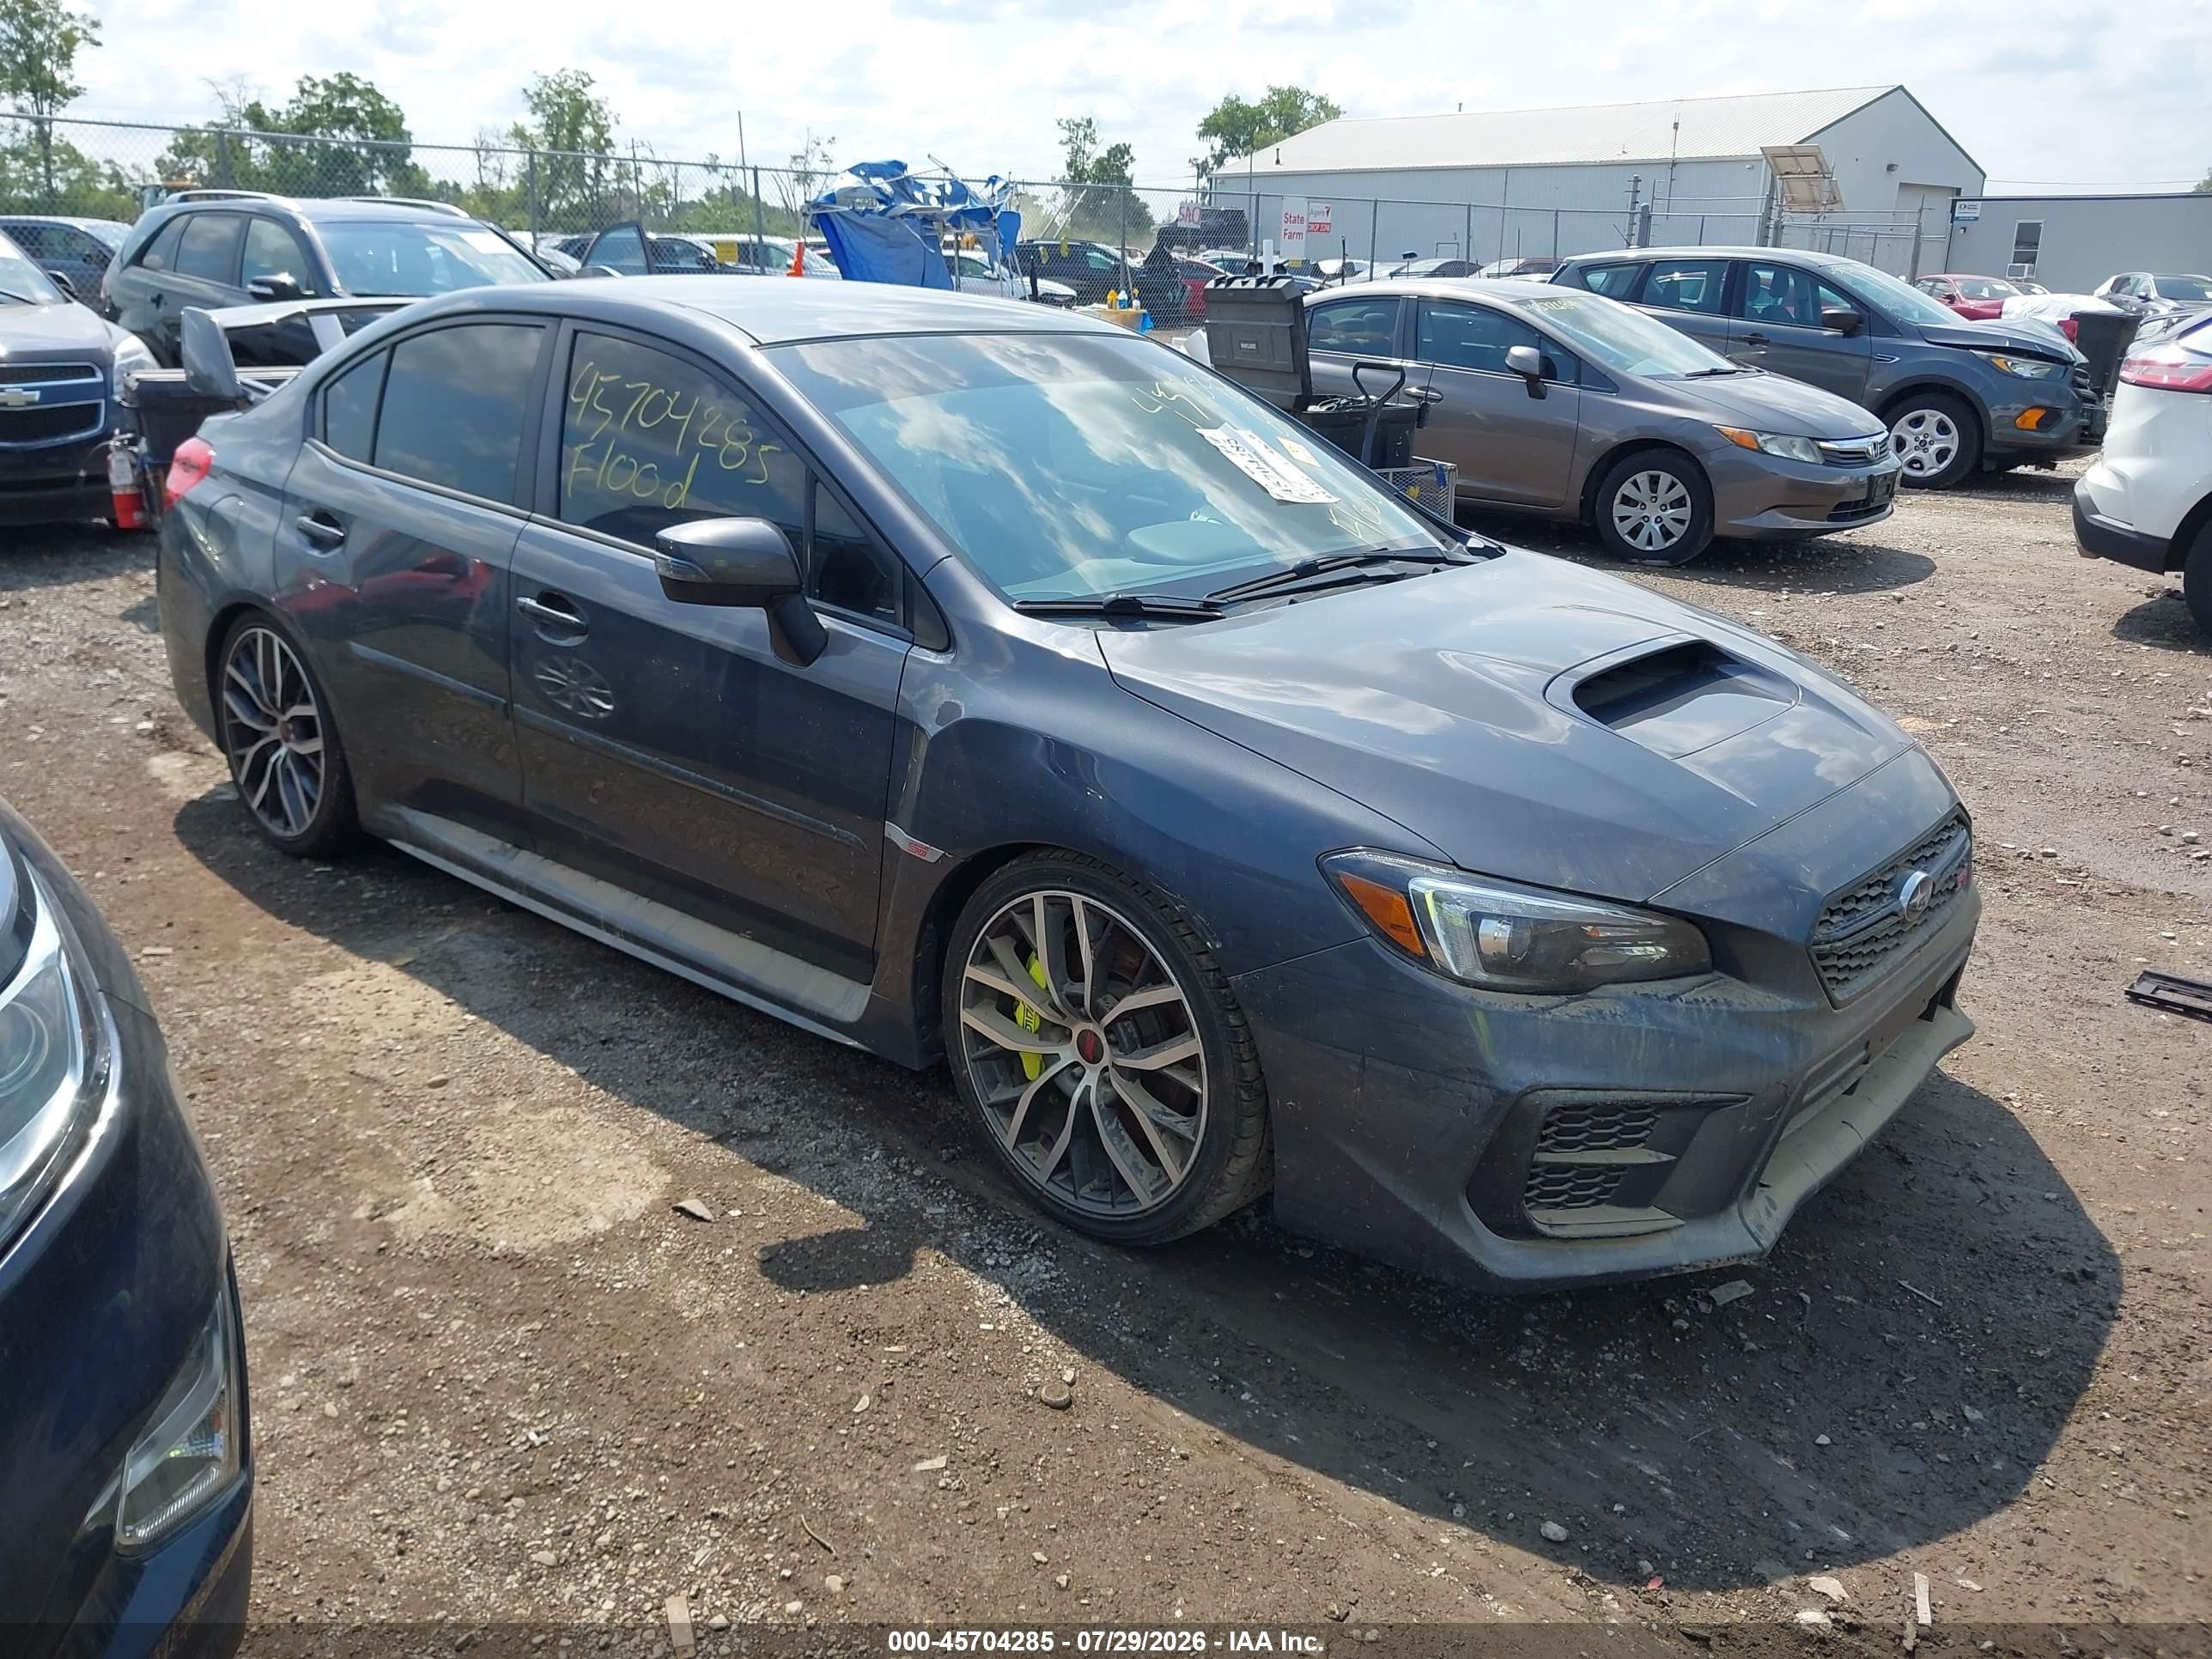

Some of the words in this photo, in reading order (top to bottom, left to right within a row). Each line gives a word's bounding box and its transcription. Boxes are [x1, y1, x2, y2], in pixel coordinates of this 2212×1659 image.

[1284, 212, 1305, 224] State
[1283, 228, 1304, 240] Farm
[570, 362, 781, 484] 45704285
